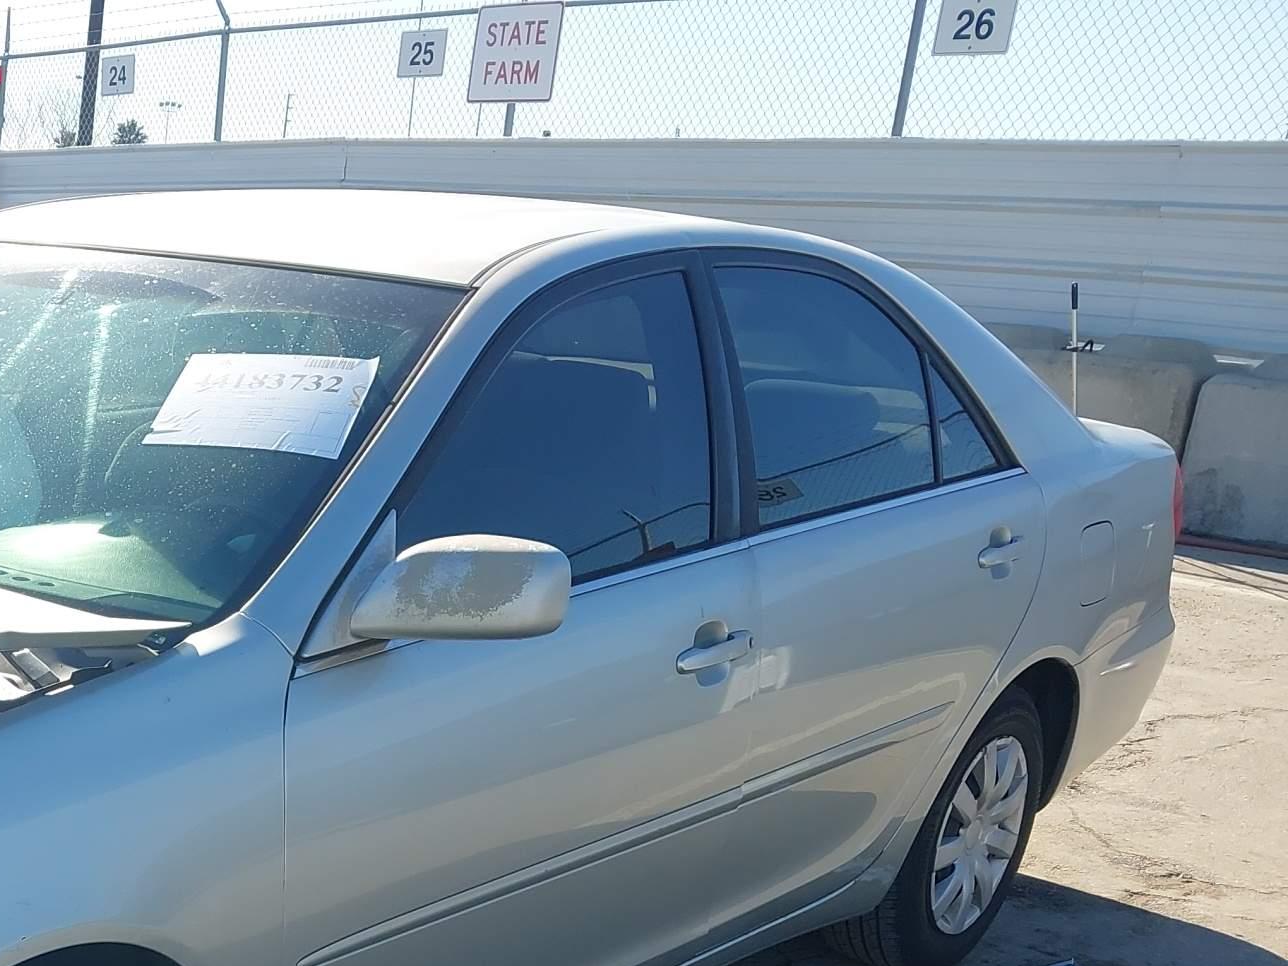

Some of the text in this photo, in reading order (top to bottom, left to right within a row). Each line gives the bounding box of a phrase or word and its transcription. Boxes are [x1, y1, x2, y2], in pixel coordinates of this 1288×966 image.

[485, 19, 549, 47] STATE
[952, 8, 996, 41] 26
[409, 41, 435, 66] 25
[108, 65, 127, 87] 24
[483, 59, 541, 85] FARM
